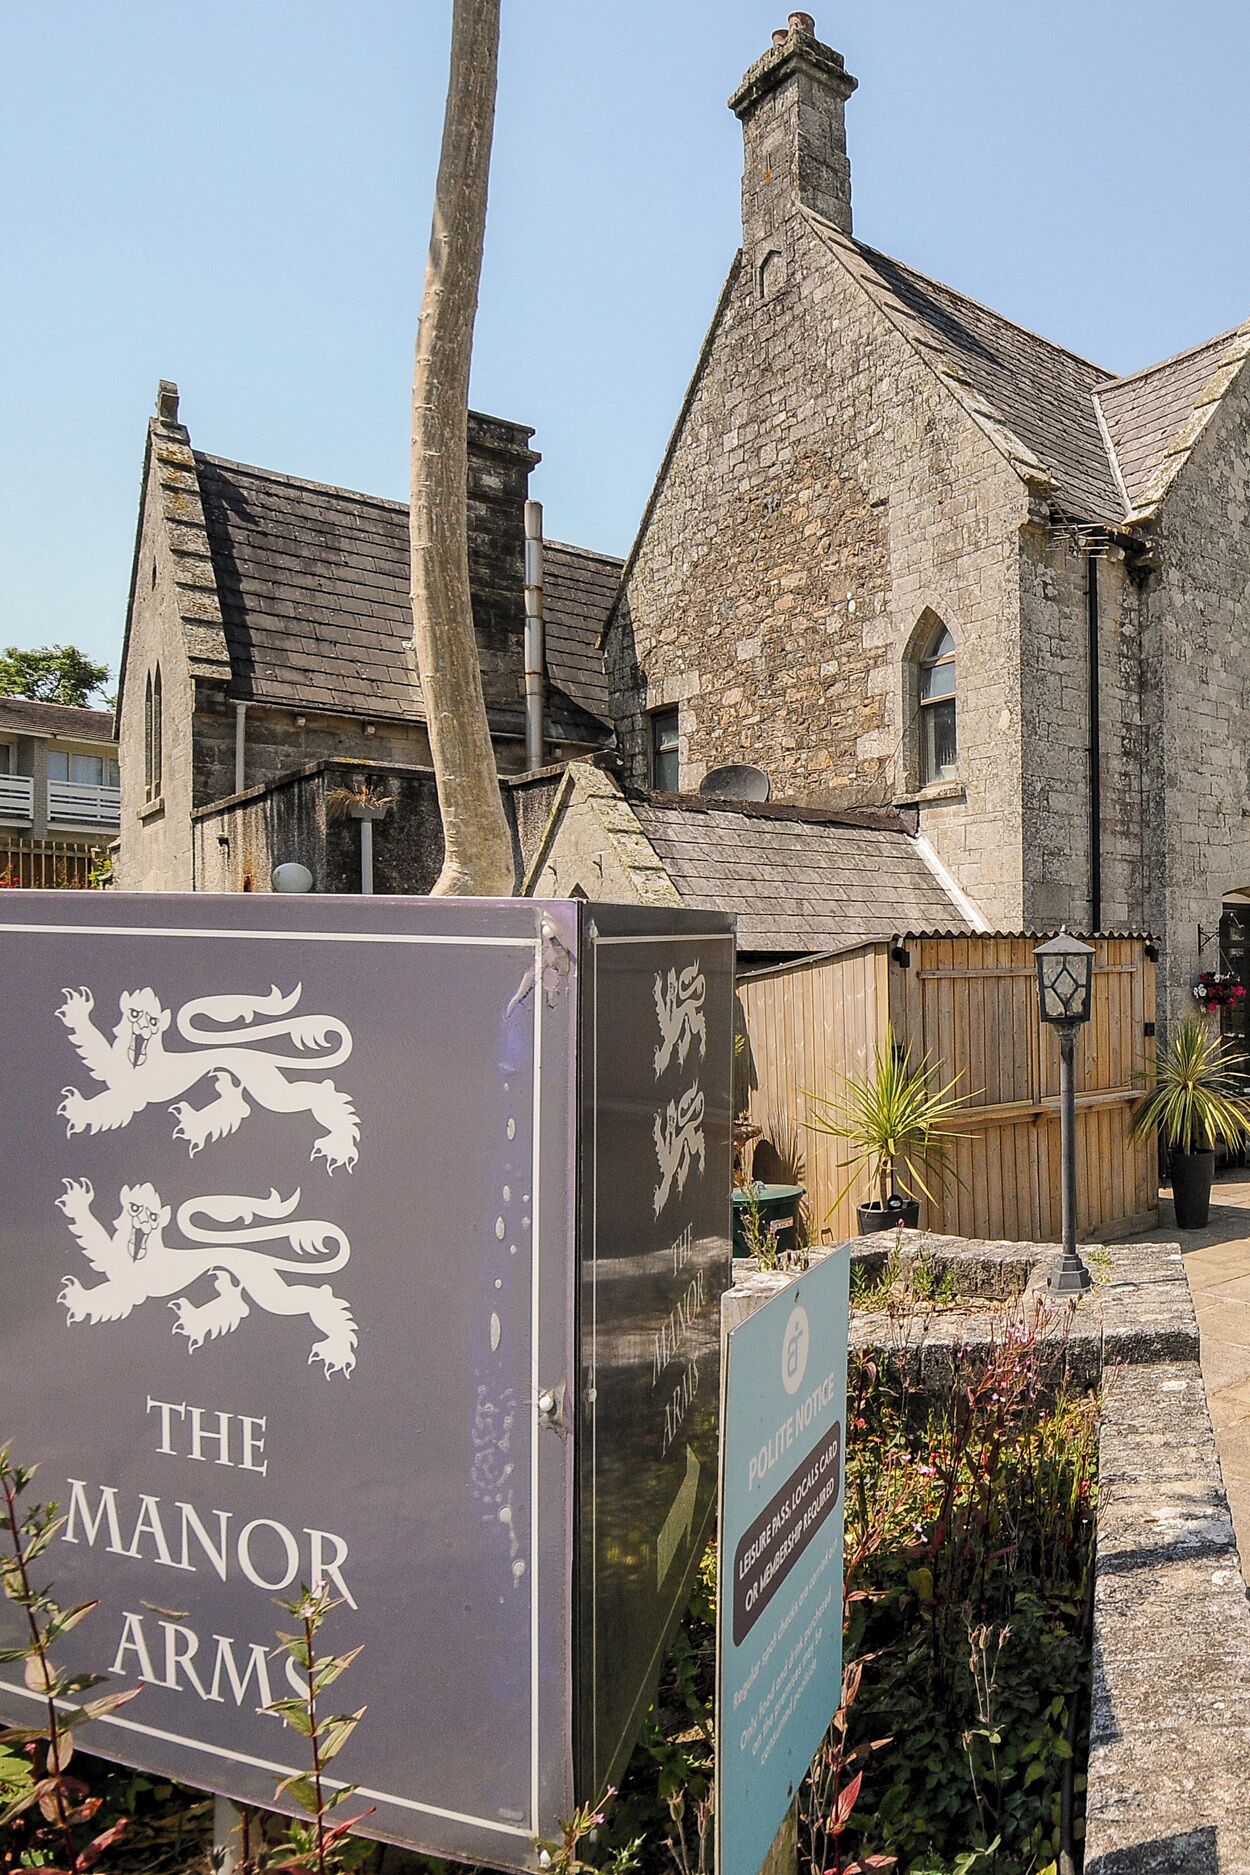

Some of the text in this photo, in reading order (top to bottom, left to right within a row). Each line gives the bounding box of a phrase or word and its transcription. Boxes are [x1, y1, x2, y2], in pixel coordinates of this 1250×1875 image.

[672, 1222, 693, 1278] THE
[652, 1269, 706, 1388] MANOR
[146, 1395, 268, 1477] THE
[661, 1350, 698, 1460] ARMS
[748, 1416, 793, 1491] POLITE
[795, 1373, 834, 1438] NOTICE
[61, 1478, 358, 1610] MANOR
[739, 1440, 837, 1580] LEISURE PASS, LOCALS CARD
[745, 1477, 834, 1611] OR MEMBERSHIP REQUIRED
